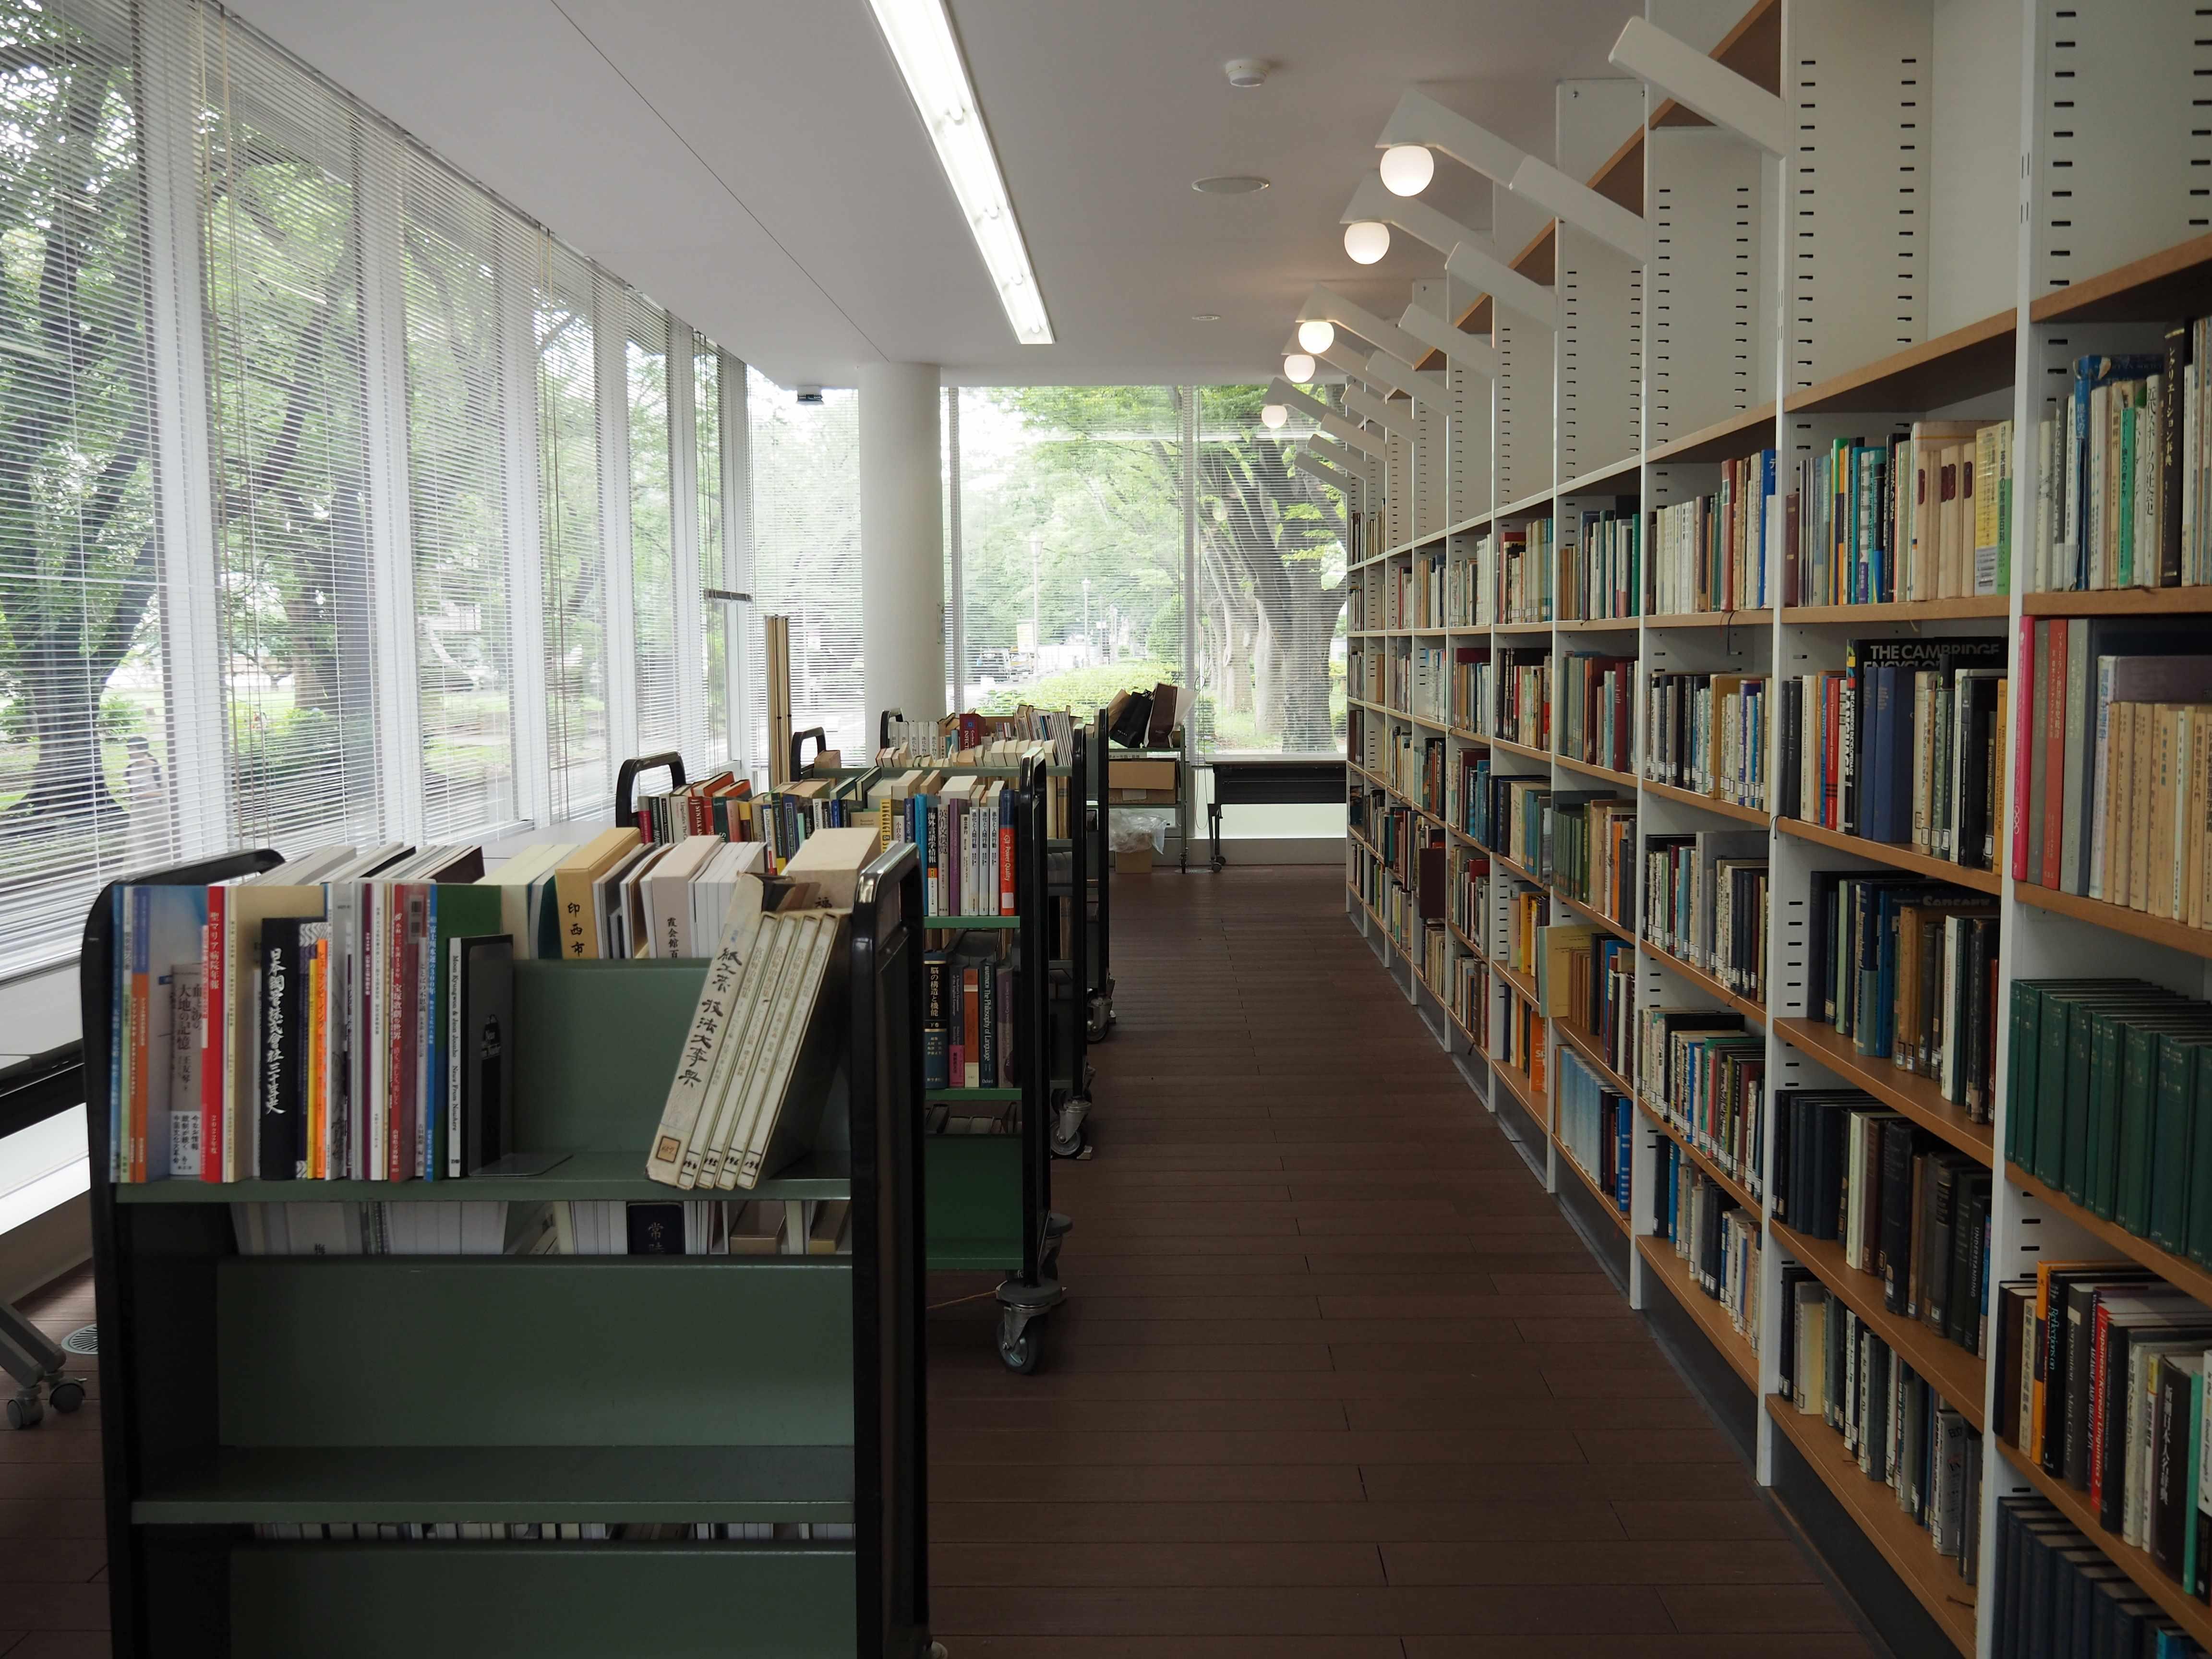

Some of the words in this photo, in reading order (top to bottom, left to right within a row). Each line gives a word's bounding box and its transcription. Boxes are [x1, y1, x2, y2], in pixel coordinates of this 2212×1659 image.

[1870, 644, 1899, 660] THE
[1901, 643, 2000, 661] CAMBRIDGE
[881, 802, 890, 834] LANGUAGE
[927, 812, 937, 863] 海外言語学情報
[938, 809, 948, 854] 英作文要覧
[209, 912, 220, 989] 聖マリア病院年報
[567, 902, 585, 957] 印西市
[177, 984, 192, 1050] 大地の記憶
[393, 983, 403, 1040] 宝塚歌劇の世界
[930, 966, 939, 1017] 脳の構造と機能
[1971, 1226, 1980, 1298] UNDERSTANDING
[2048, 1306, 2059, 1357] Reflections
[2049, 1358, 2056, 1370] on
[2097, 1326, 2106, 1419] Japanese/Korean
[2095, 1421, 2104, 1478] Linguistics
[2095, 1479, 2102, 1488] 2
